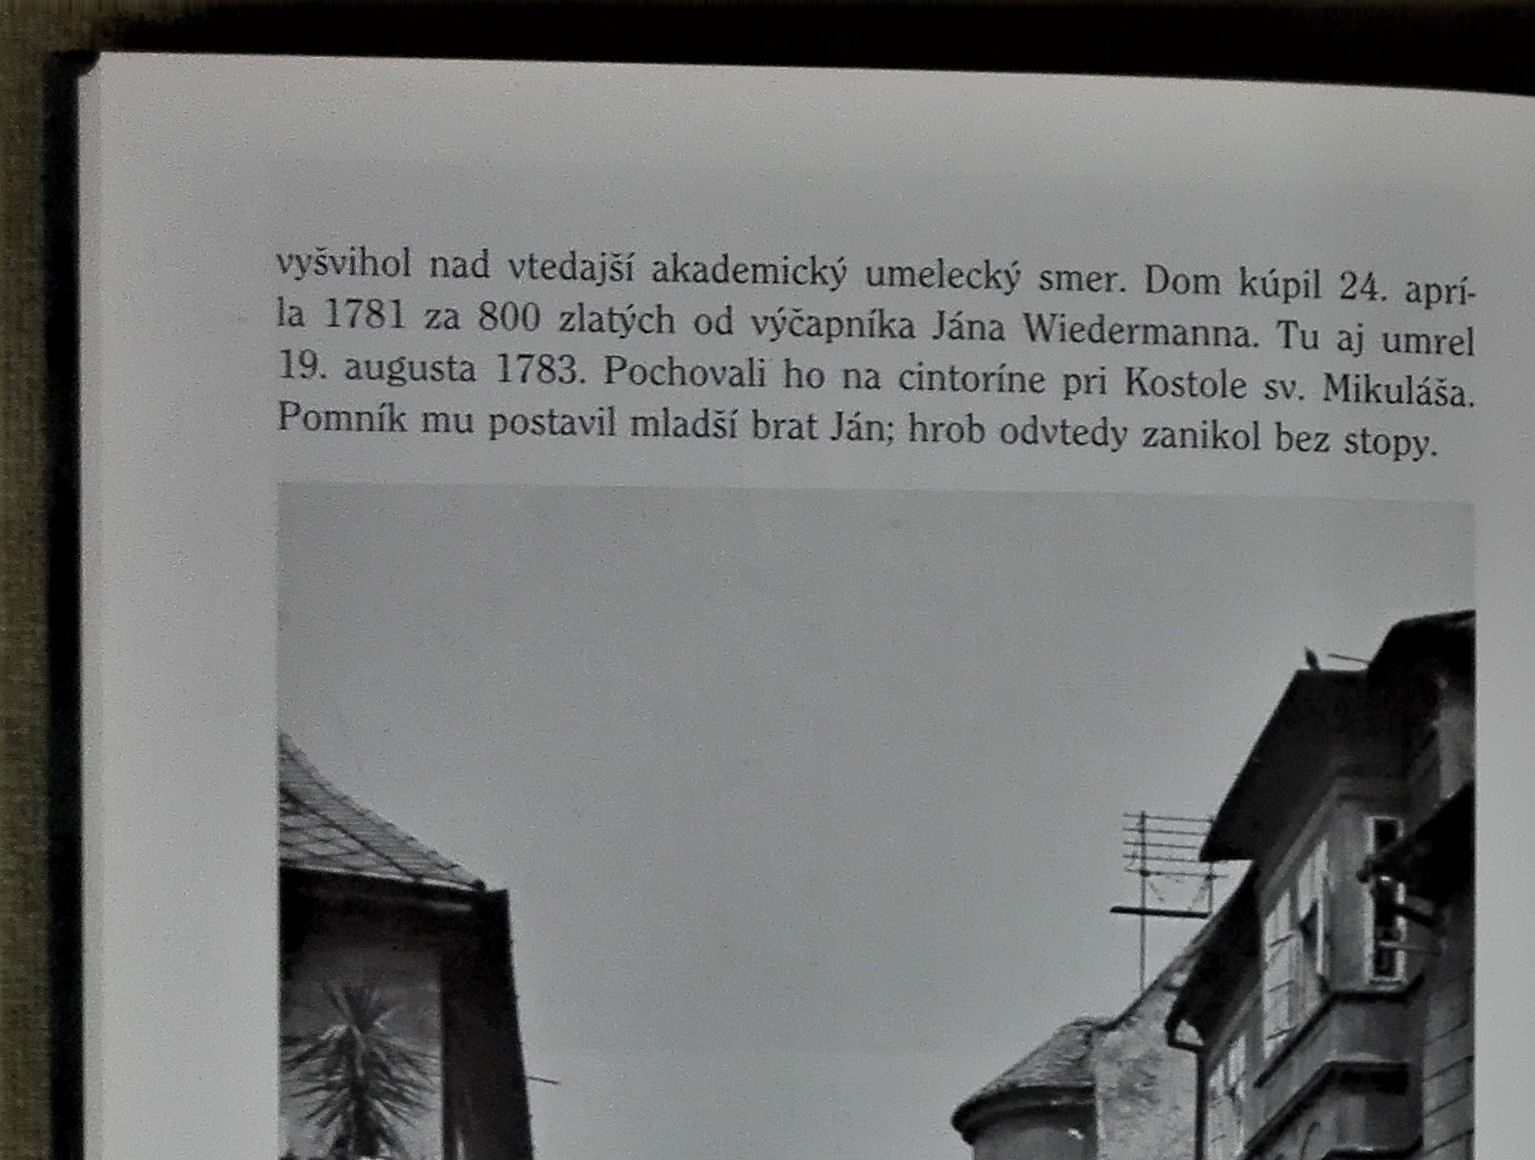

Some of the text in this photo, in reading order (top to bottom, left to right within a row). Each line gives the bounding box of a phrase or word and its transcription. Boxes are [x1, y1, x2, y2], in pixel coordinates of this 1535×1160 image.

[275, 244, 1477, 311] vyšvihol nad vtedajší akademický umelecký smer. Dom kúpil 24. aprí-
[276, 295, 1475, 359] la 1781 za 800 zlatých od výčapníka Jána Wiedermanna. Tu aj umrel
[279, 348, 1475, 409] 19. augusta 1783. Pochovali ho na cintoríne pri Kostole sv. Mikuláša.
[277, 399, 1439, 463] Pomník mu postavil mladší brat Ján; hrob odvtedy zanikol bez stopy.
